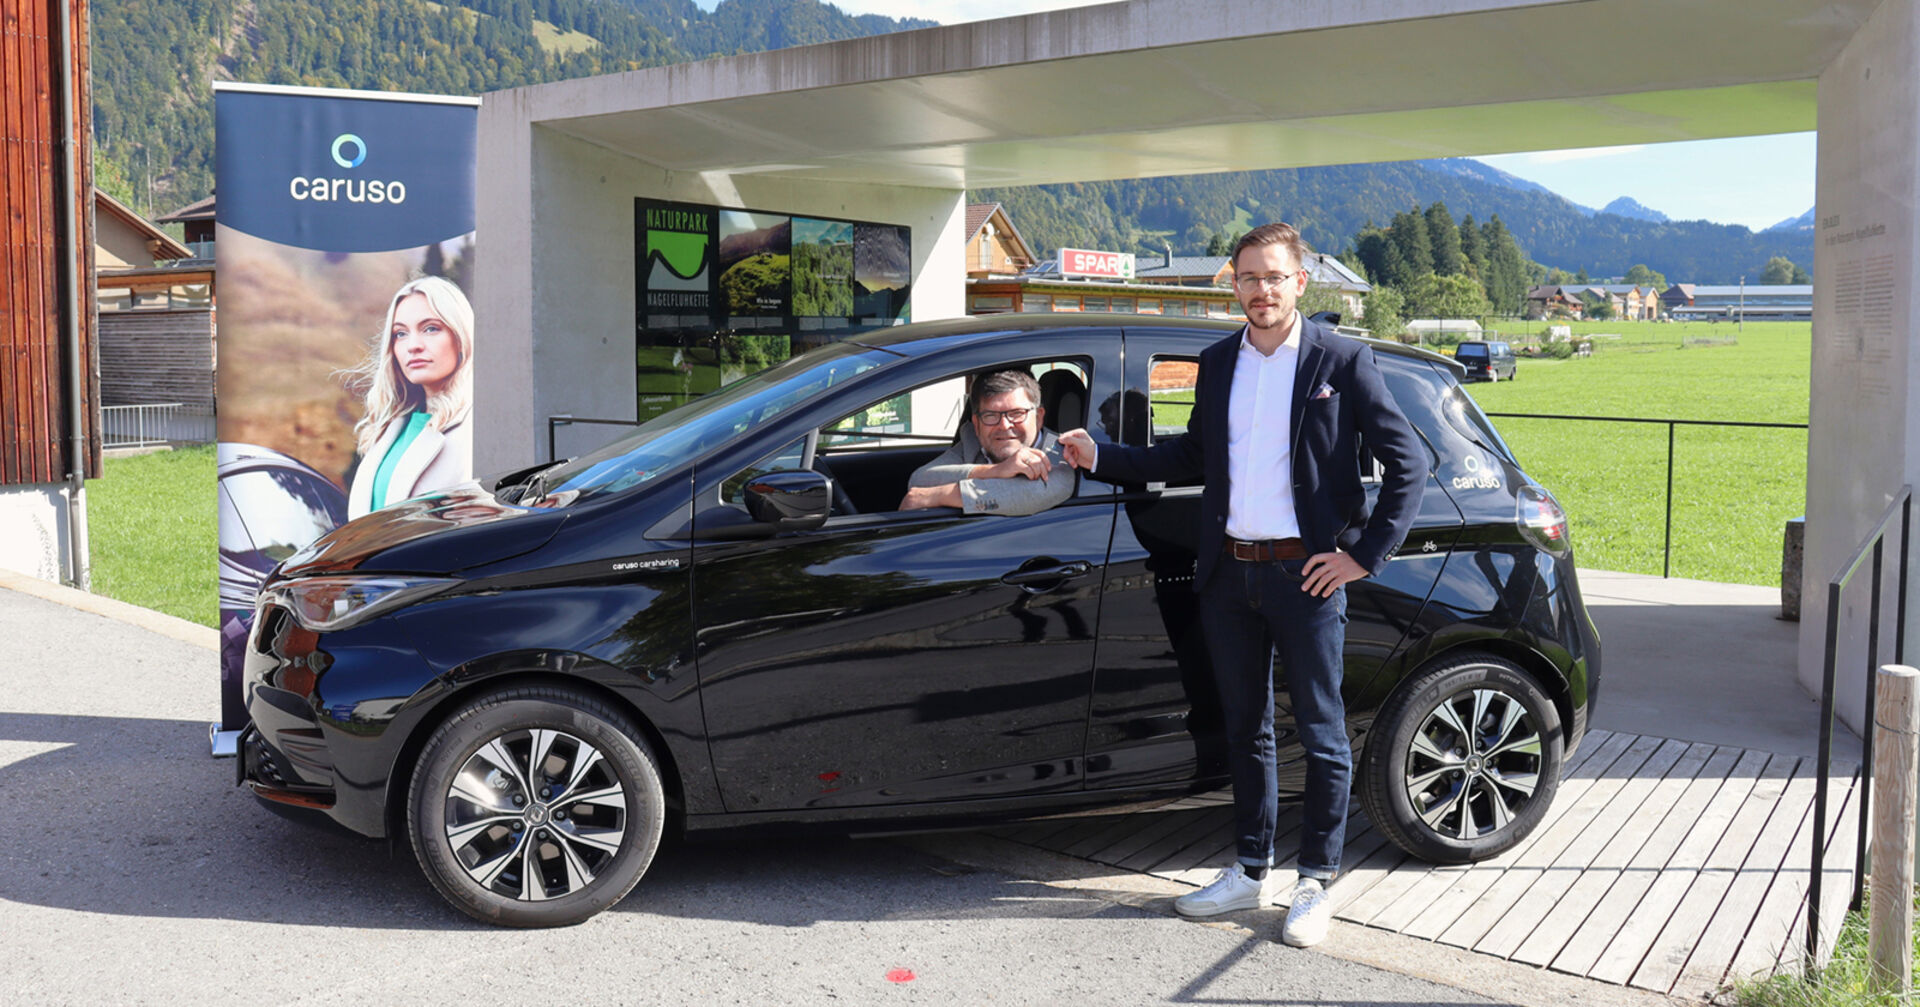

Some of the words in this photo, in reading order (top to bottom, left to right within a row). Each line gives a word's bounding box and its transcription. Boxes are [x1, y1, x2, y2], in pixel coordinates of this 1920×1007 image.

[290, 176, 406, 204] caruso
[647, 208, 709, 232] NATURPARK
[1074, 253, 1118, 273] SPAR
[647, 292, 709, 308] NAGELFLUHKETTE
[1452, 476, 1501, 489] caruso
[612, 562, 639, 570] caruso
[639, 558, 680, 569] carsharing
